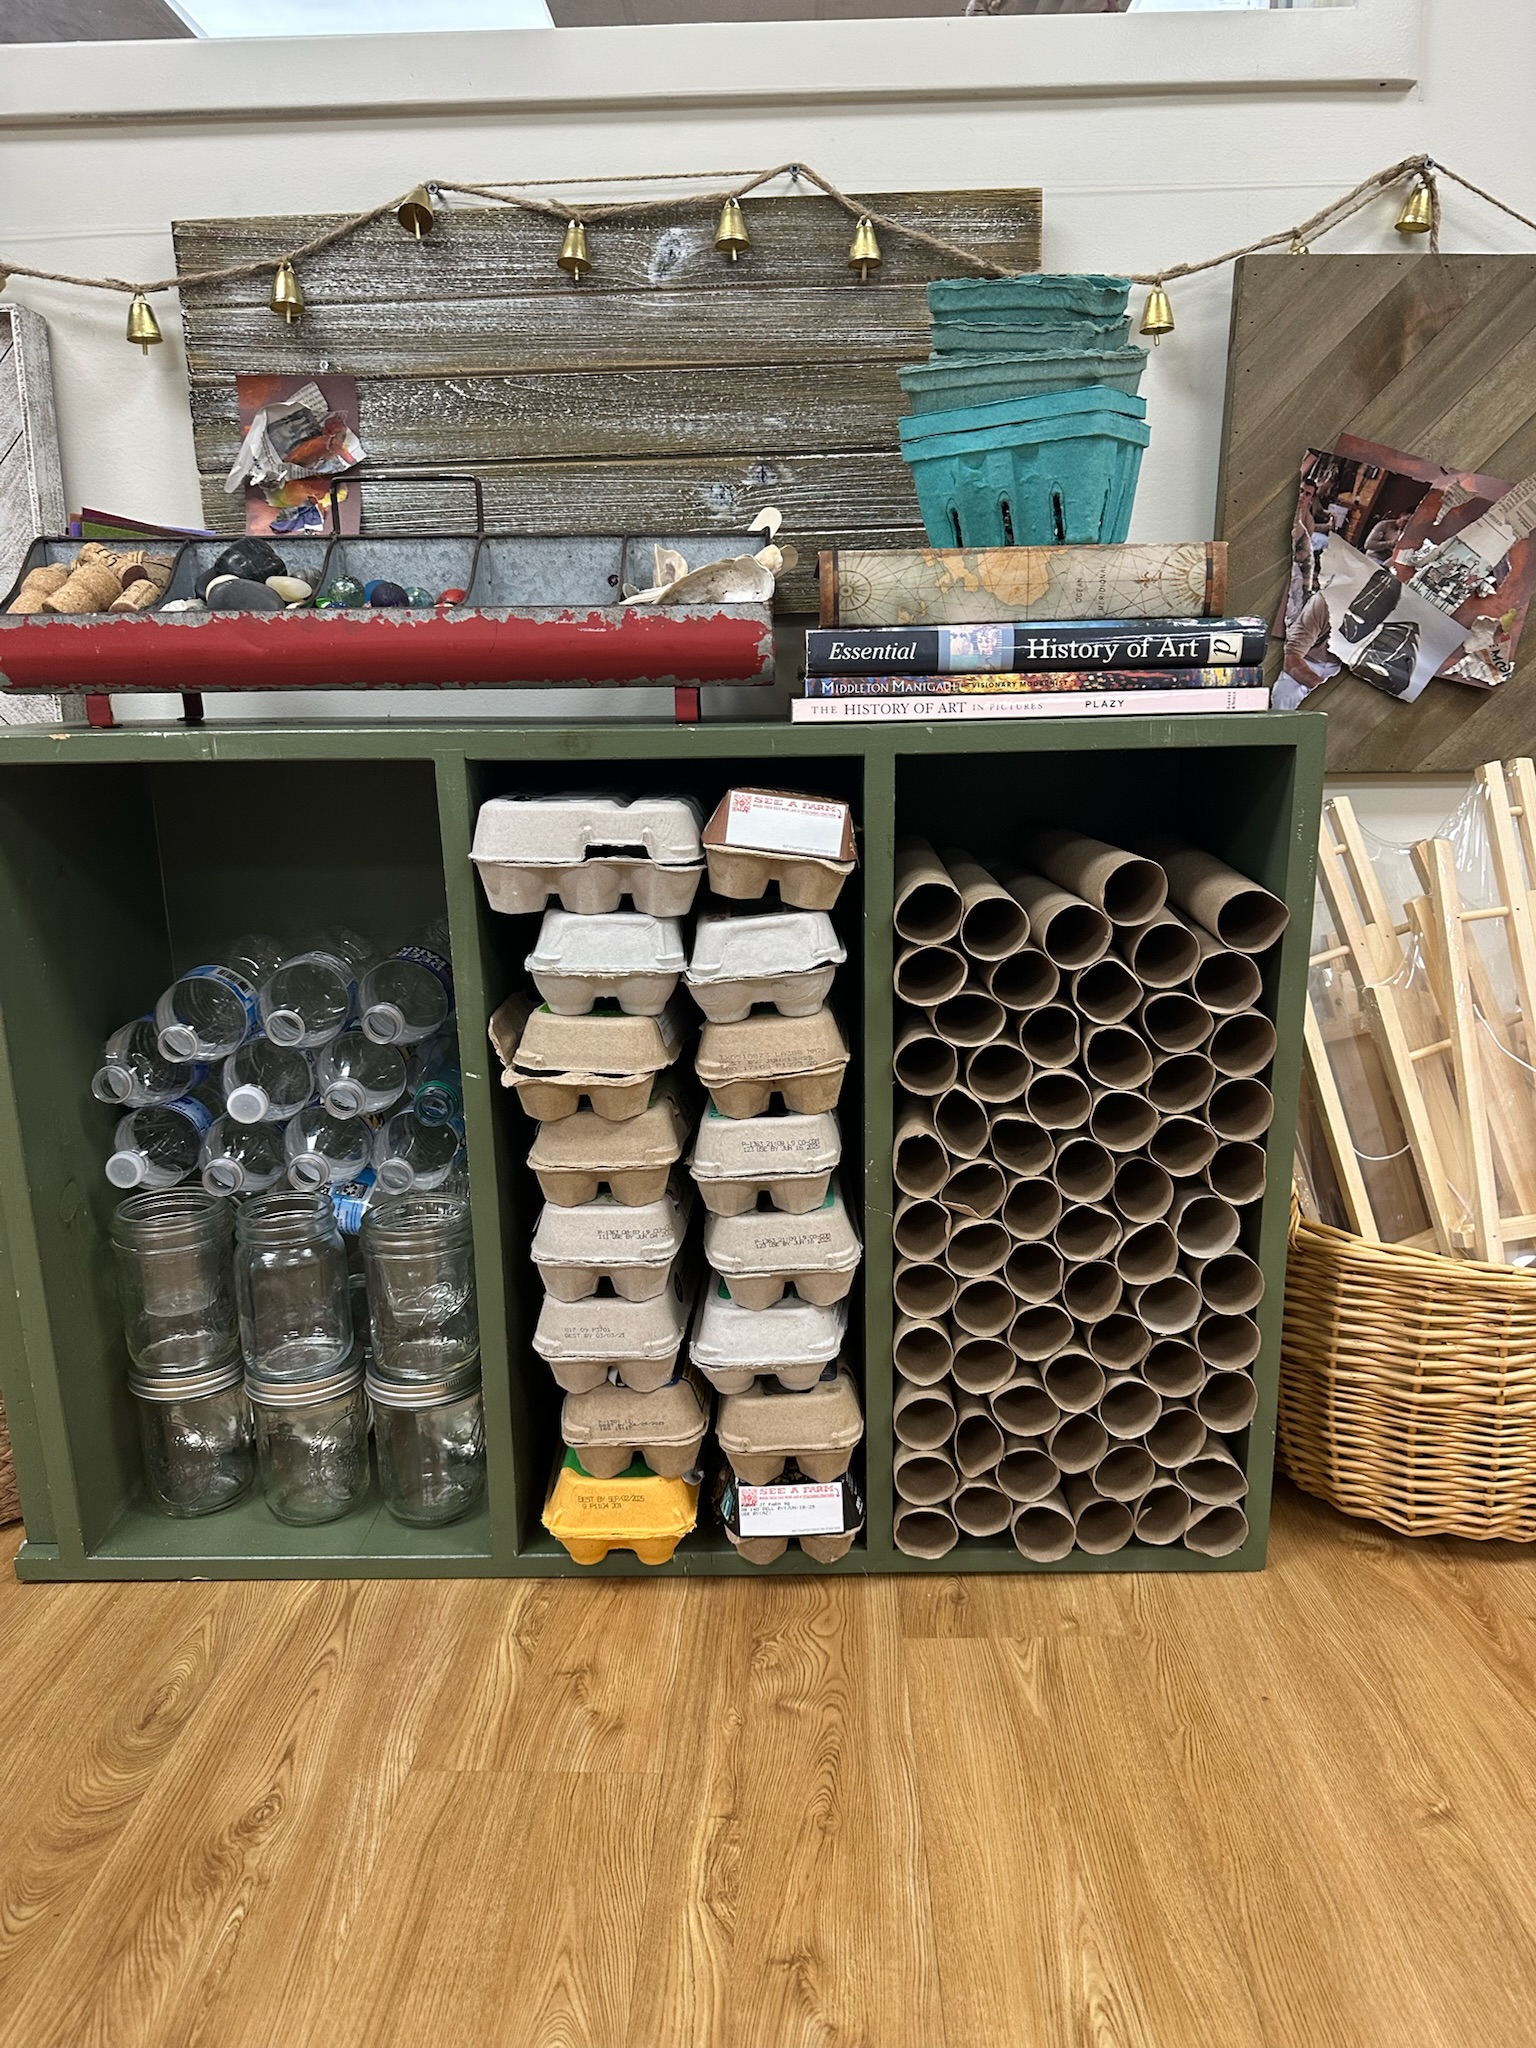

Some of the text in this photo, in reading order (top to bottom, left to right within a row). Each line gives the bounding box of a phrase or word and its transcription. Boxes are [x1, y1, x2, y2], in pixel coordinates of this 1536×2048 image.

[828, 637, 1199, 664] Essential History of Art
[821, 681, 889, 694] MIDDLETON
[971, 681, 1016, 689] VISIONARY
[811, 705, 837, 714] THE
[844, 702, 911, 715] HISTORY
[914, 702, 934, 714] OF
[938, 701, 967, 714] ART
[989, 703, 1043, 711] PICTURES
[1085, 699, 1125, 709] PLAZY
[753, 796, 783, 806] SEE
[802, 802, 836, 812] FARM
[759, 1487, 786, 1495] SEE
[803, 1485, 834, 1494] FARM
